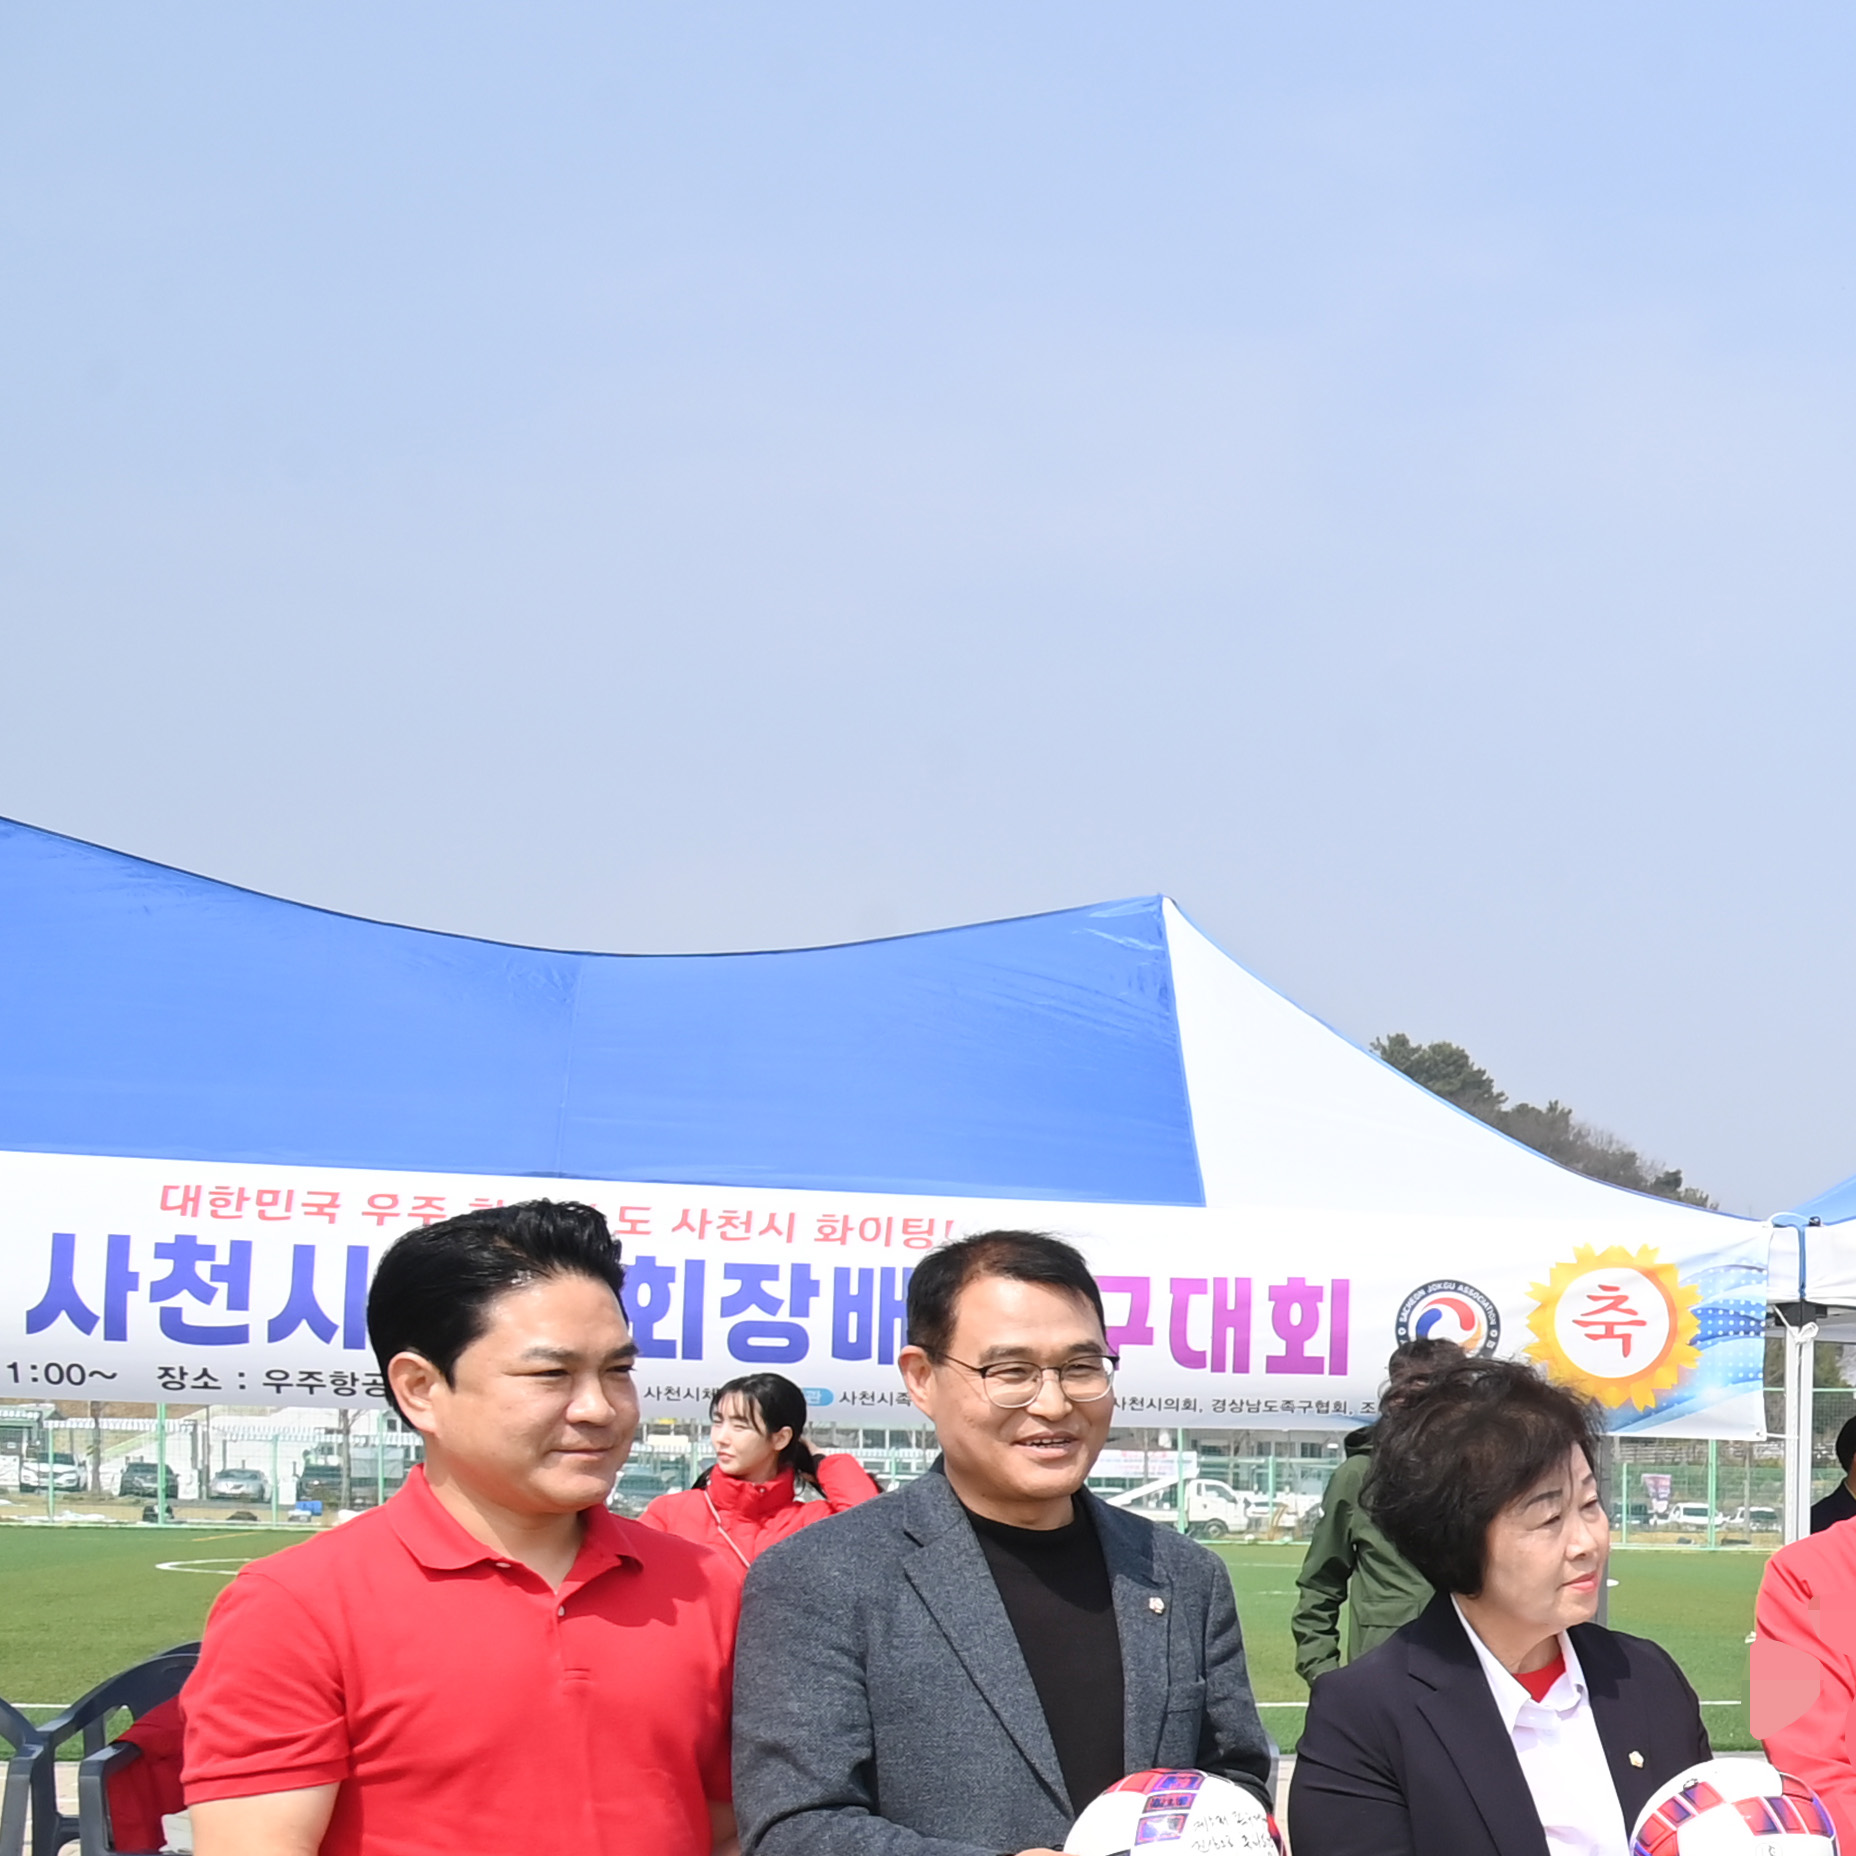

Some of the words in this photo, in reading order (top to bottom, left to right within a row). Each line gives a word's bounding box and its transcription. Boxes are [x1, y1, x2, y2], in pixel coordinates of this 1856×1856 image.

[160, 1184, 342, 1224] 대한민국
[361, 1193, 447, 1229] 우주
[672, 1207, 796, 1244] 사천시
[814, 1213, 953, 1250] 화이팅!
[1093, 1275, 1350, 1376] 구대회
[1427, 1281, 1456, 1294] JOKGU
[1457, 1284, 1497, 1326] ASSOCIATION
[1572, 1284, 1648, 1358] 축
[157, 1365, 227, 1392] 장소
[262, 1368, 390, 1397] 우주항공
[643, 1385, 720, 1402] 사천시체
[838, 1388, 912, 1407] 사천시족
[1211, 1398, 1354, 1415] 경상남도족구협회,
